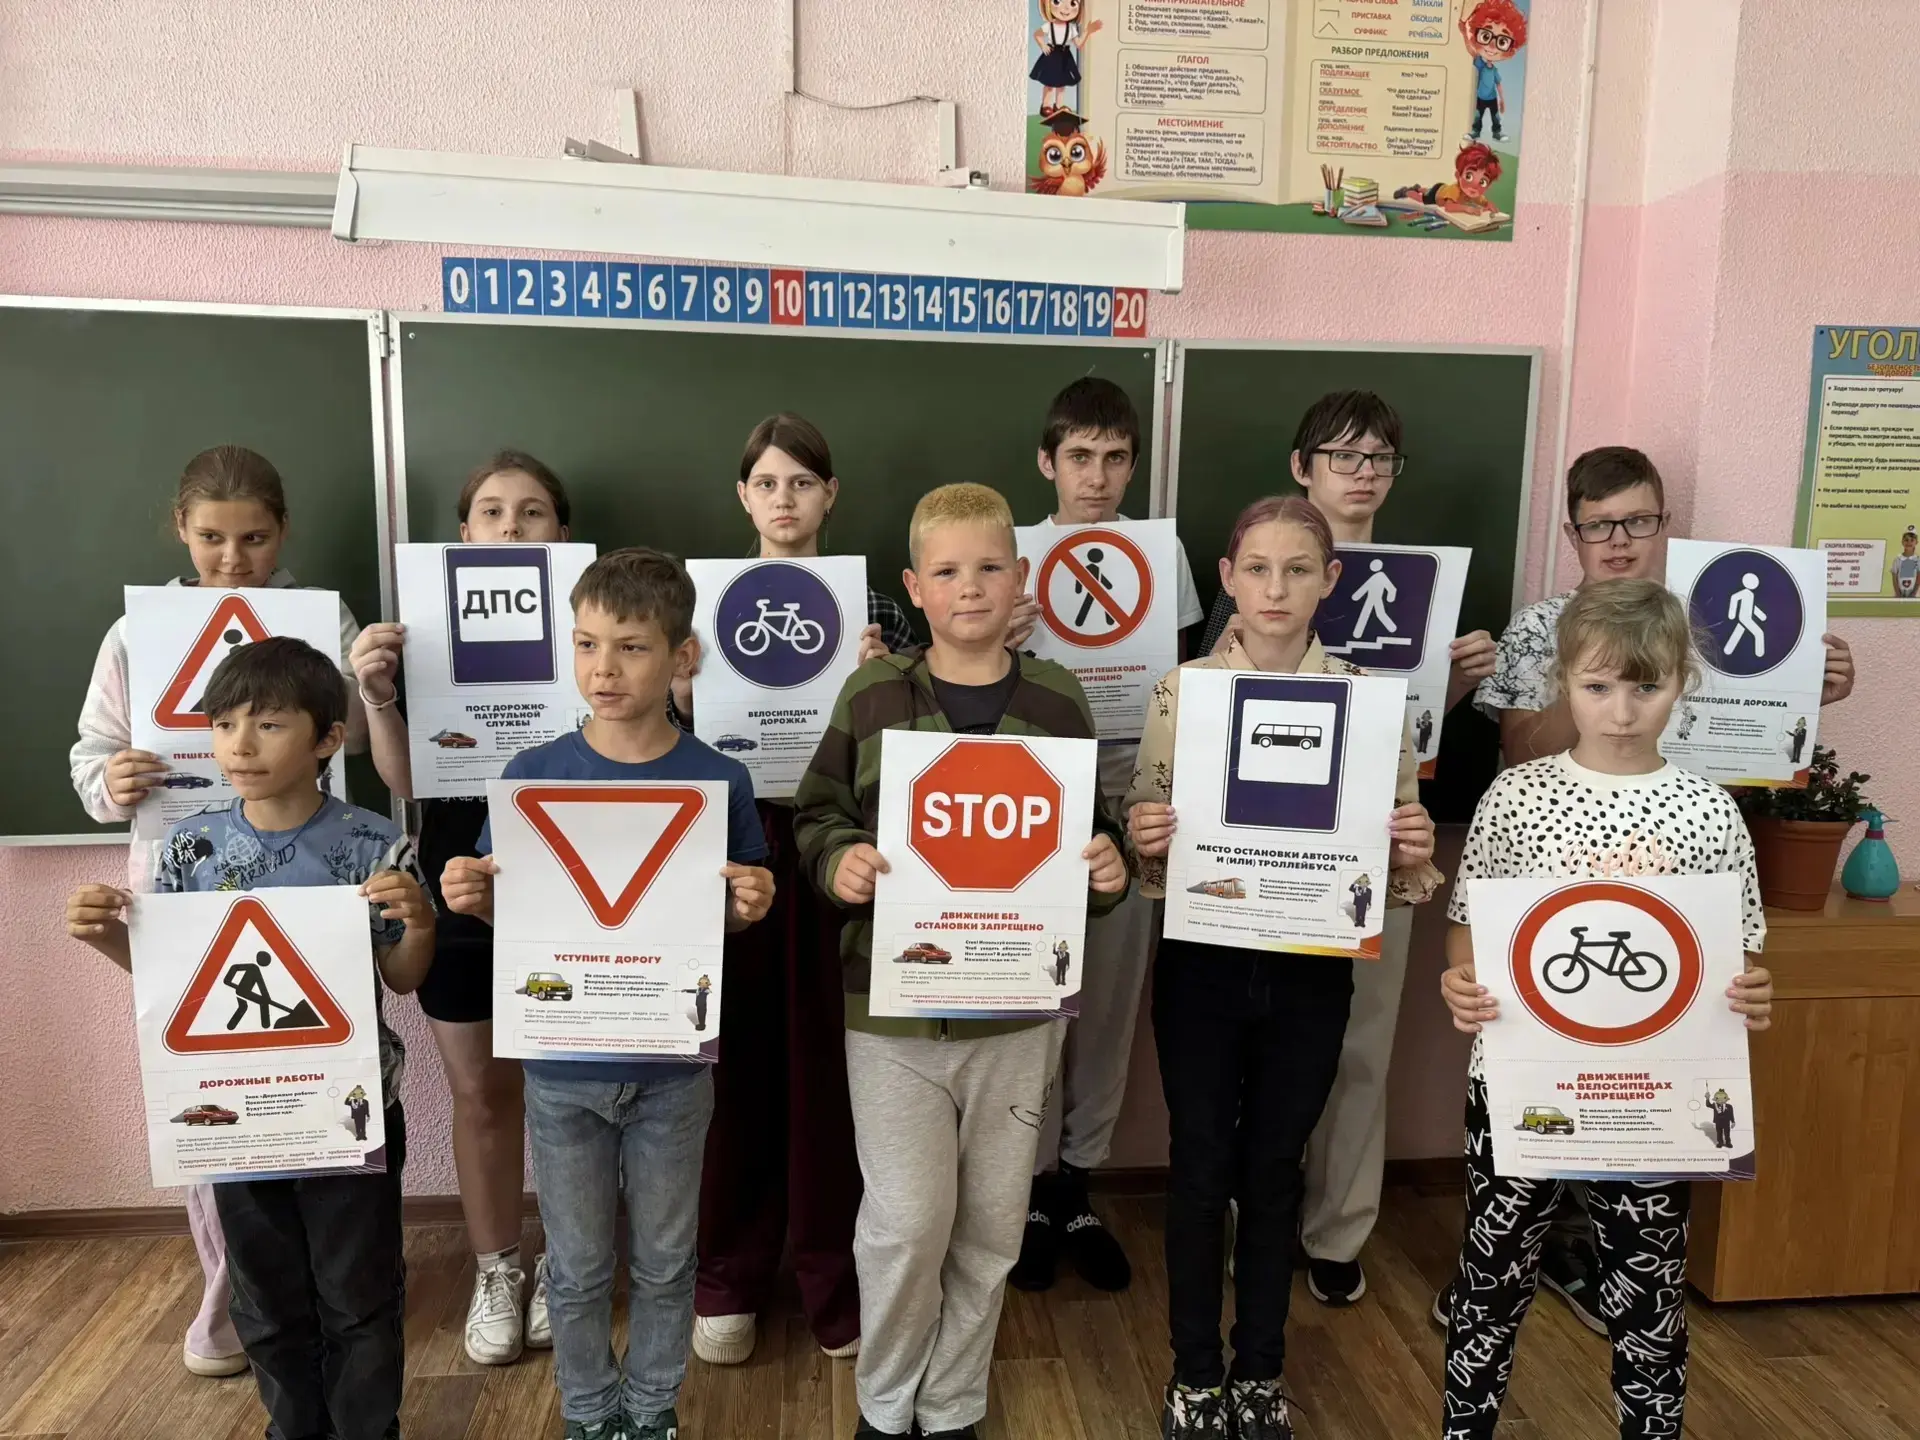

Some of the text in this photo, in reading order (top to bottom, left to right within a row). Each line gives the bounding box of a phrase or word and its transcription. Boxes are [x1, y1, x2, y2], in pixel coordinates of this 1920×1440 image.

[1351, 12, 1392, 20] ПРИСТАВКА
[1410, 15, 1443, 23] ОБОШЛИ
[1354, 27, 1388, 36] СУФФИКС
[1408, 30, 1443, 39] РЕЧЕНЬКА
[1331, 46, 1429, 59] РАЗБОР ПРЕДЛОЖЕНИЯ
[1177, 55, 1209, 65] ГЛАГОЛ
[1320, 69, 1370, 78] ПОДЛЕЖАЩЕЕ
[1319, 87, 1360, 95] СКАЗУЕМОЕ
[1318, 105, 1368, 114] ОПРЕДЕЛЕНИЕ
[1157, 118, 1224, 128] МЕСТОИМЕНИЕ
[1317, 123, 1365, 132] ДОПОЛНЕНИЕ
[1316, 141, 1378, 150] ОБСТОЯТЕЛЬСТВО
[450, 267, 1144, 329] 0 1 2 3 4 5 6 7 8 9 10 11 12 13 14 15 16 17 18 19 20
[1828, 328, 1920, 361] УГОЛ
[462, 588, 537, 619] ДПС
[1095, 665, 1147, 673] ПЕШЕХОДОВ
[1078, 674, 1122, 682] АПРЕЩЕНО
[493, 703, 548, 712] ДОРОЖНО-
[1743, 698, 1787, 708] ДОРОЖКА
[474, 711, 541, 720] ПАТРУЛЬНОЙ
[748, 709, 818, 718] ВЕЛОСИПЕДНАЯ
[486, 719, 530, 727] СЛУЖБЫ
[760, 717, 807, 726] ДОРОЖКА
[922, 791, 1051, 839] STOP
[1196, 843, 1359, 863] МЕСТО ОСТАНОВКИ АВТОБУСА
[1226, 856, 1256, 867] (ИЛИ)
[1258, 859, 1337, 872] ТРОЛЛЕЙБУСА
[940, 912, 1020, 920] ДВИЖЕНИЕ БЕЗ
[914, 922, 1044, 931] ОСТАНОВКИ ЗАПРЕЩЕНО
[554, 953, 662, 964] УСТУПИТЕ ДОРОГУ
[199, 1073, 324, 1089] ДОРОЖНЫЕ РАБОТЫ
[1577, 1072, 1650, 1082] ДВИЖЕНИЕ
[1556, 1082, 1673, 1091] НА ВЕЛОСИПЕДАХ
[1575, 1092, 1655, 1101] ЗАПРЕЩЕНО
